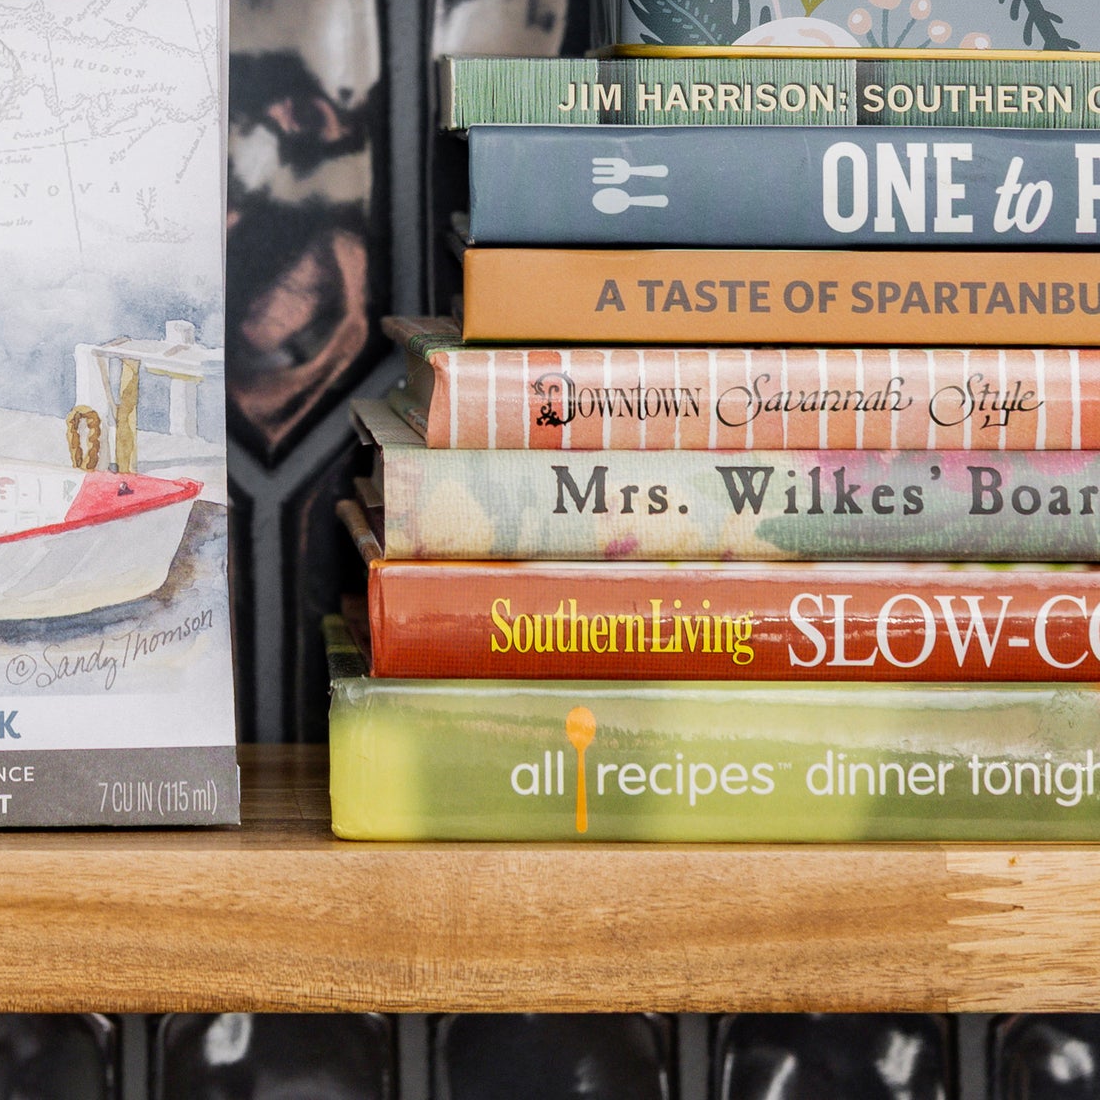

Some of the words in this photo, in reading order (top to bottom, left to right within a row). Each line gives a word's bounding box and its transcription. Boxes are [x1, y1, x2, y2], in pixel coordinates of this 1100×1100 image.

[557, 82, 623, 113] JIM
[638, 83, 847, 112] HARRISON:
[863, 83, 1073, 114] SOUTHERN
[821, 140, 974, 234] ONE
[993, 156, 1054, 234] to
[594, 279, 626, 312] A
[637, 279, 775, 313] TASTE
[783, 279, 838, 313] OF
[715, 373, 914, 427] Savannah
[928, 372, 1045, 429] Style
[551, 465, 689, 516] Mrs.
[113, 608, 213, 668] Thomson
[788, 592, 1100, 670] SLOW-C
[98, 782, 109, 812] 7
[112, 782, 133, 812] CU
[137, 781, 153, 812] IN
[158, 781, 189, 816] (115
[193, 780, 218, 815] ml)
[510, 751, 565, 798] all
[805, 750, 955, 798] dinner
